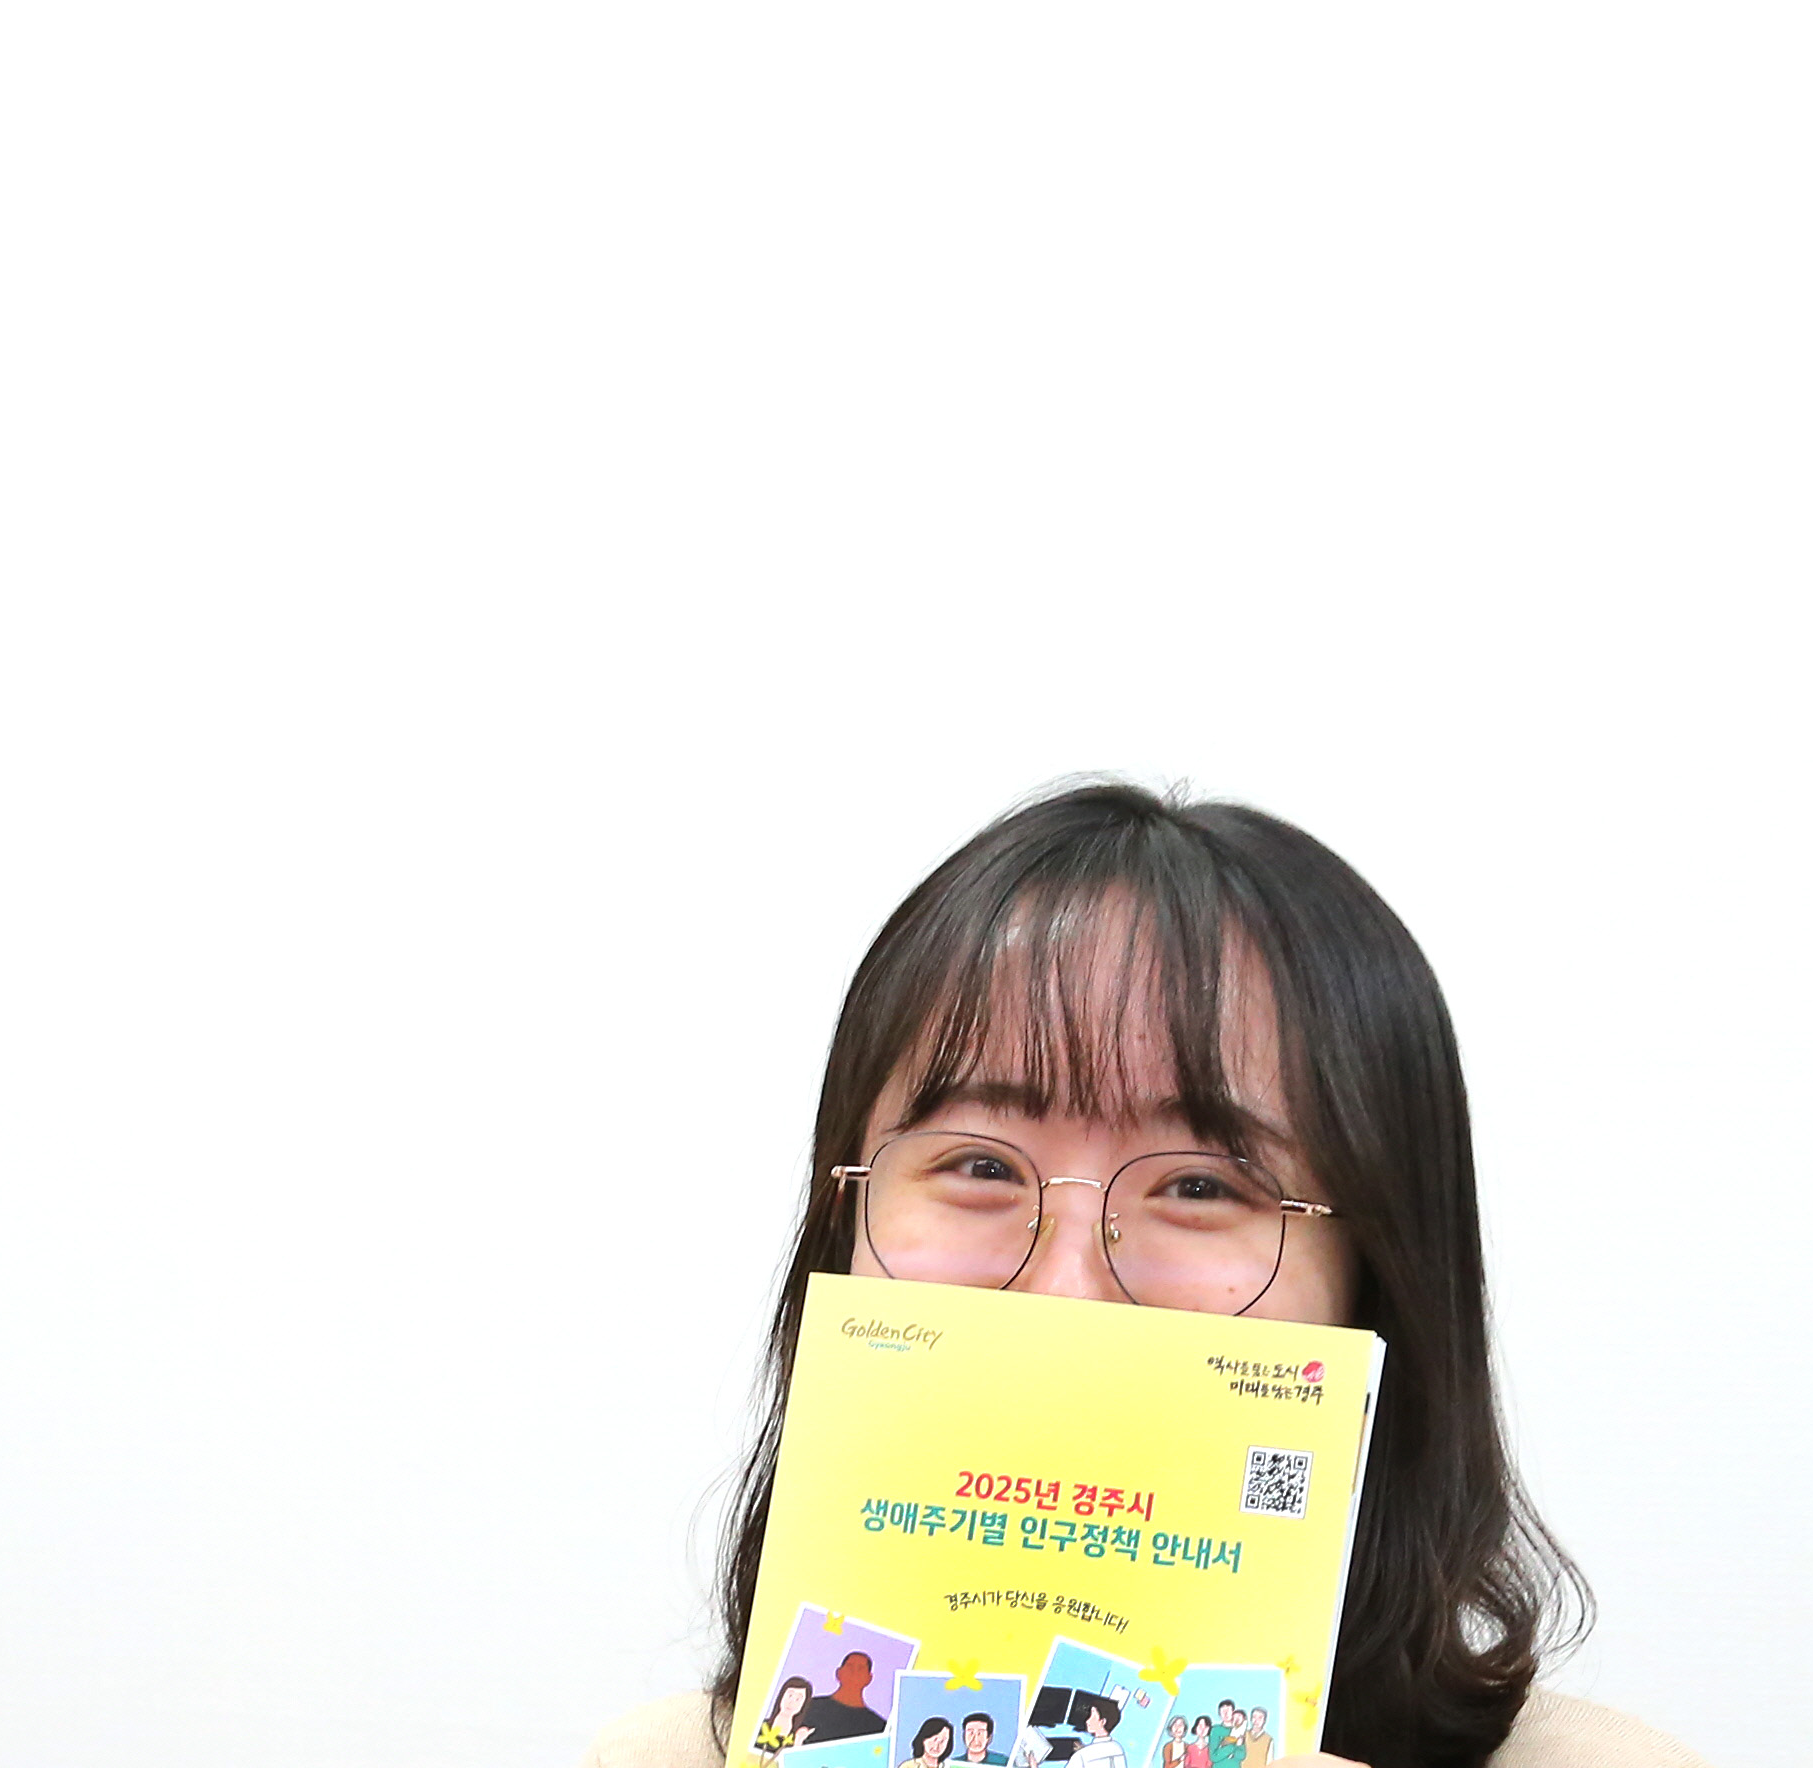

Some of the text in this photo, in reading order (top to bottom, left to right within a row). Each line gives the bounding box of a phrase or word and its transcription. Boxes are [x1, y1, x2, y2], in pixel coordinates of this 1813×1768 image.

[841, 1317, 944, 1351] Golden City
[1294, 1384, 1324, 1406] 경주
[955, 1470, 1155, 1522] 2025년 경주시
[860, 1498, 1243, 1573] 생애주기별 인구정책 안내서
[944, 1590, 1129, 1635] 경주시가 당신을 응원합니다!
